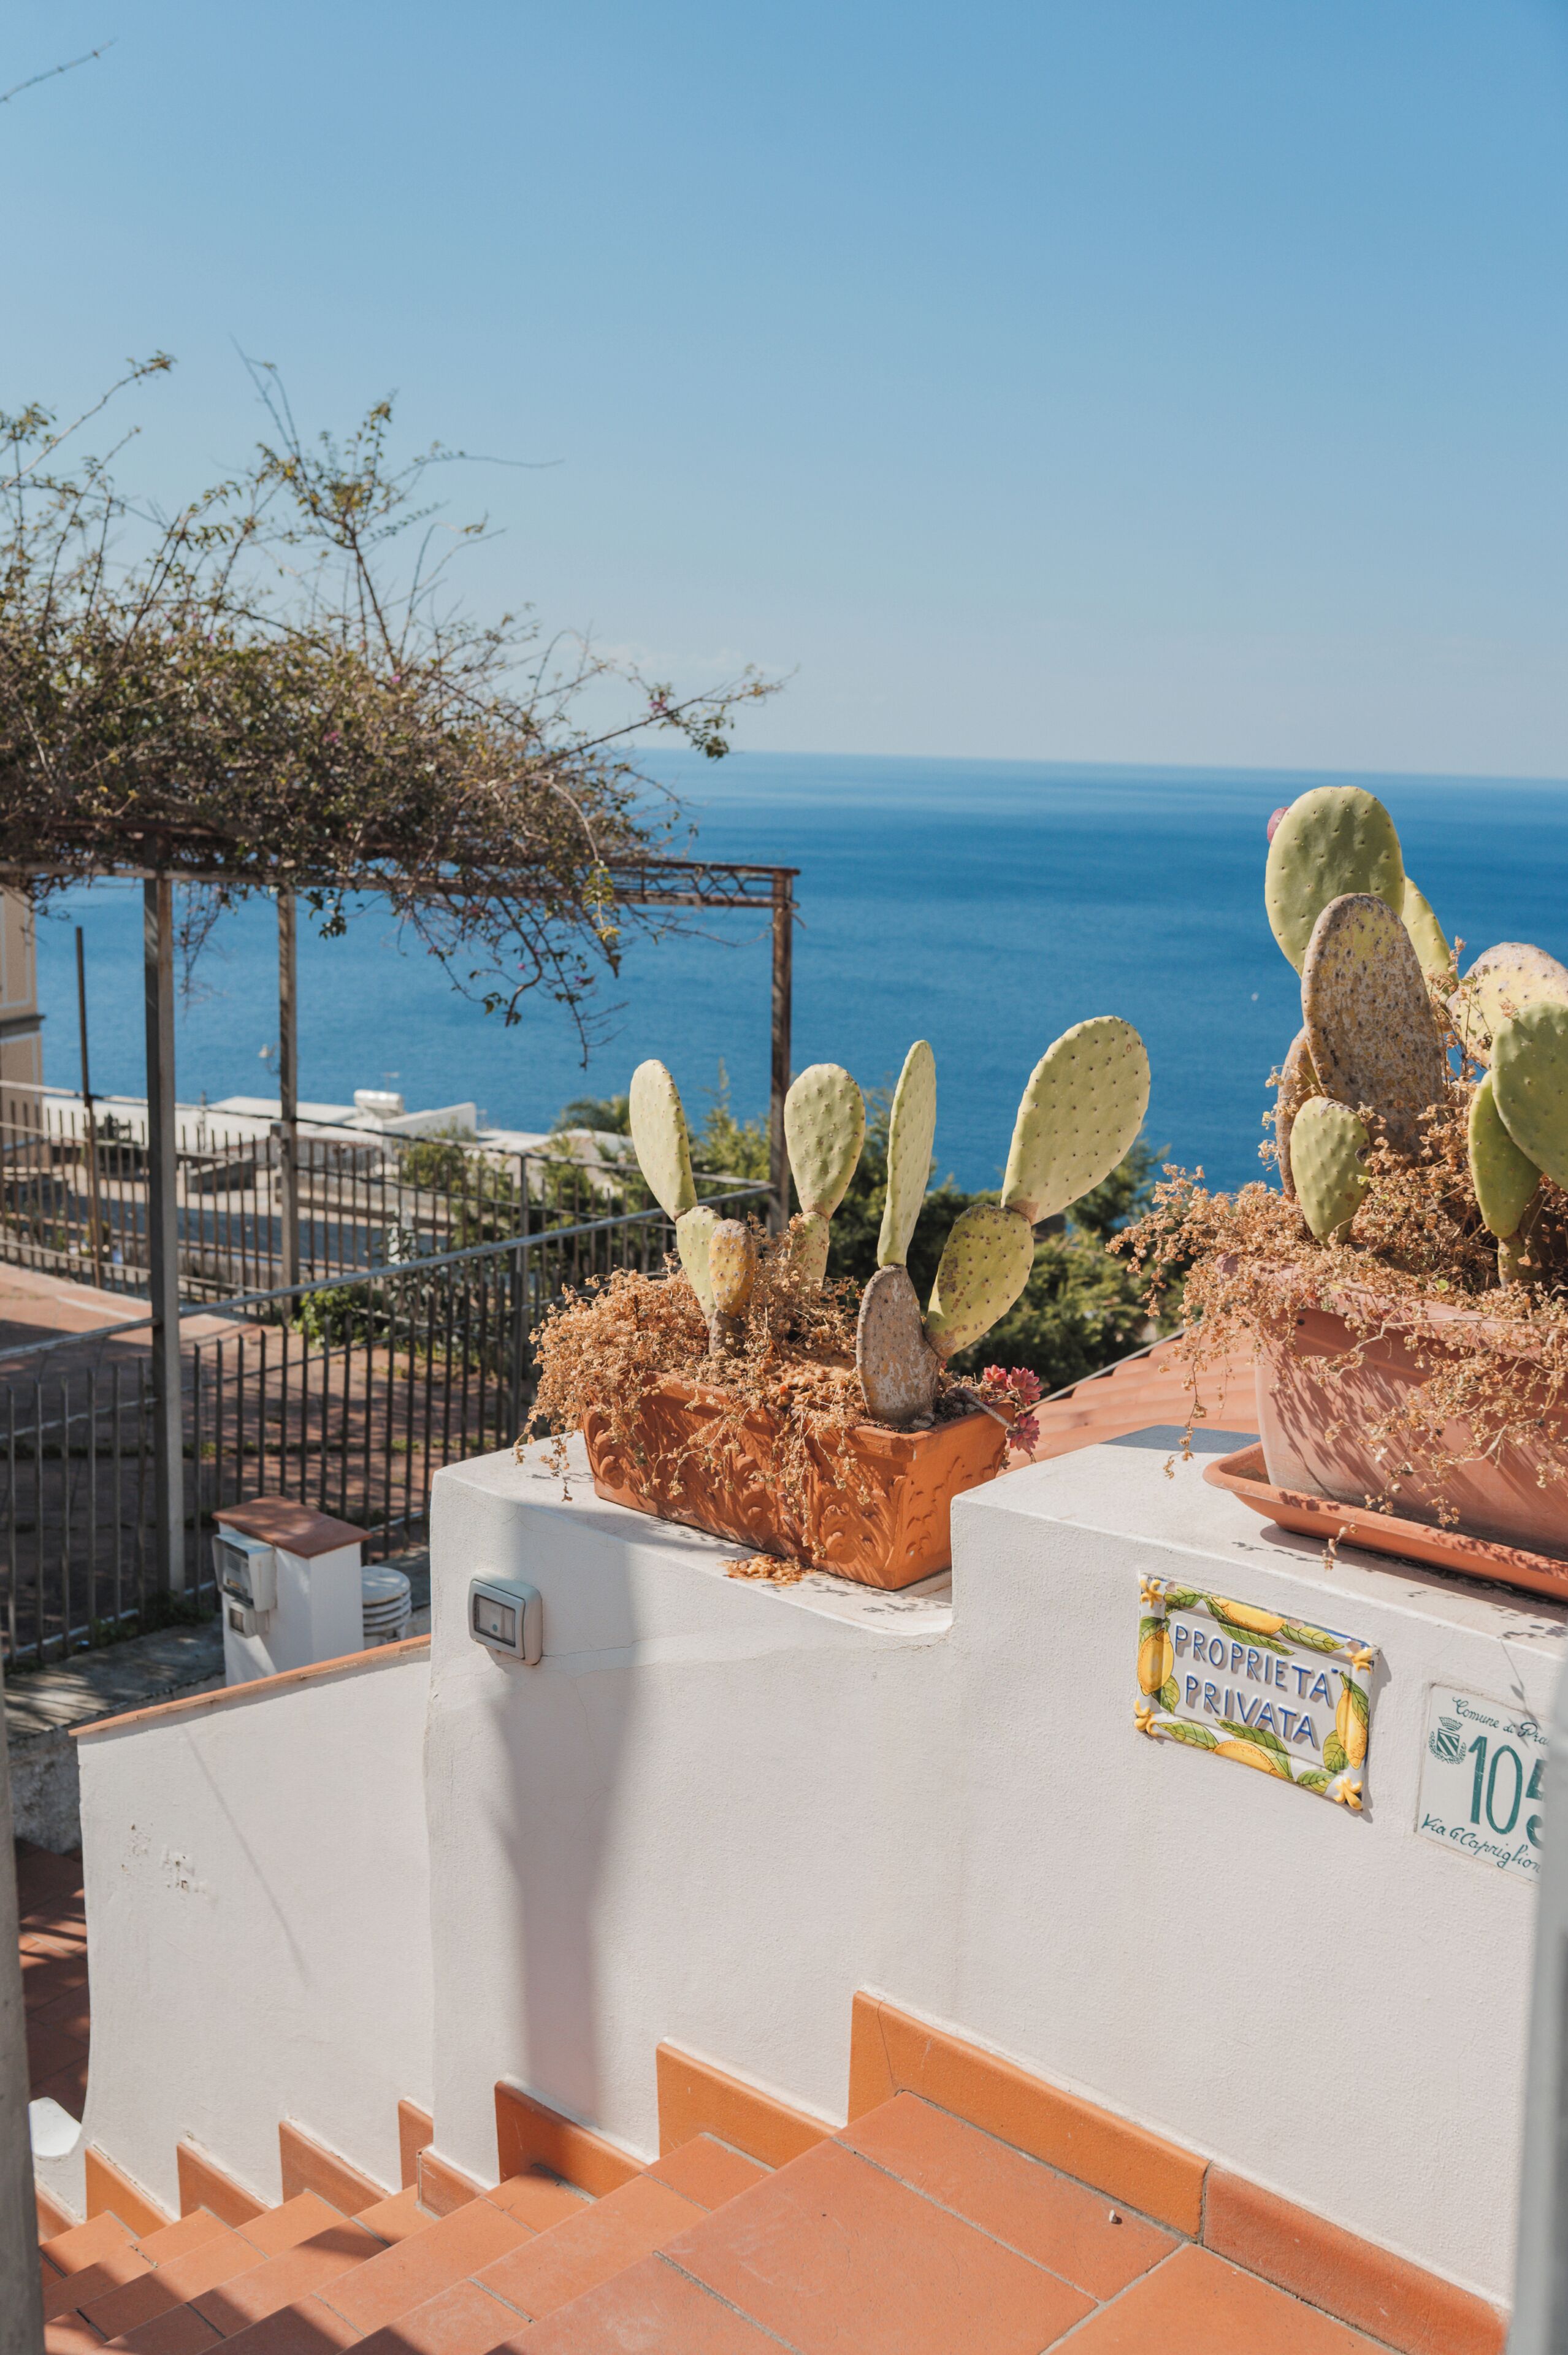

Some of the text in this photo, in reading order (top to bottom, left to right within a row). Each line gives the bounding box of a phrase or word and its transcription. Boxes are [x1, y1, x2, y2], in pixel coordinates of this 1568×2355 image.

[1185, 1674, 1316, 1748] PRIVATA
[1452, 1696, 1550, 1747] Comune di Pra
[1421, 1813, 1445, 1837] Via
